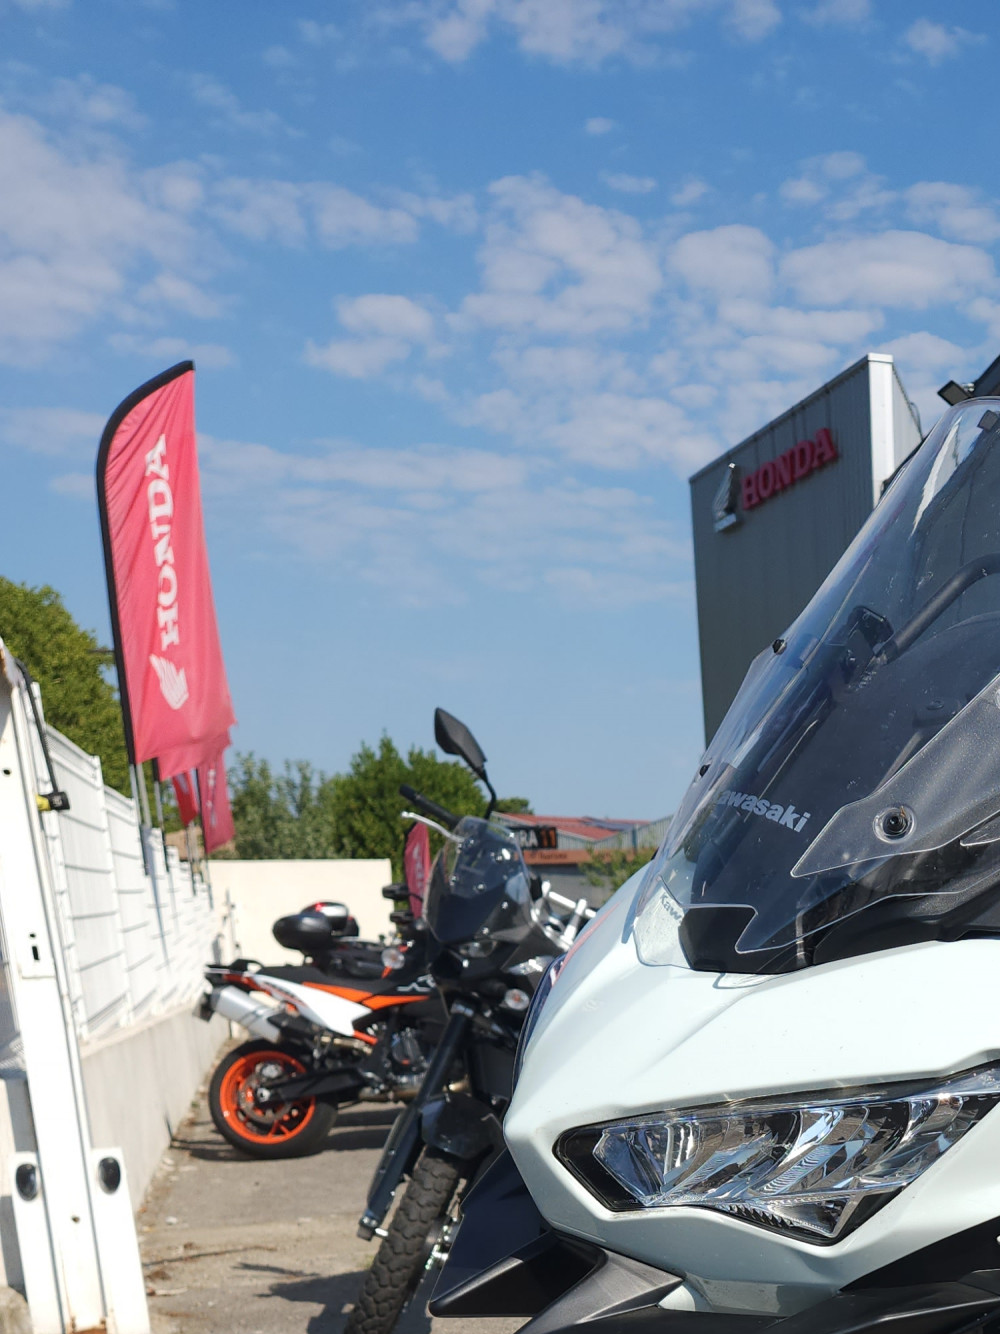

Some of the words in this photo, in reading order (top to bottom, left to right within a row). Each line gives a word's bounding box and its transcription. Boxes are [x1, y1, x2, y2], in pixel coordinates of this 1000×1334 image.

[742, 427, 839, 510] HONDA
[144, 433, 179, 651] HONDA
[716, 790, 811, 832] awasaki
